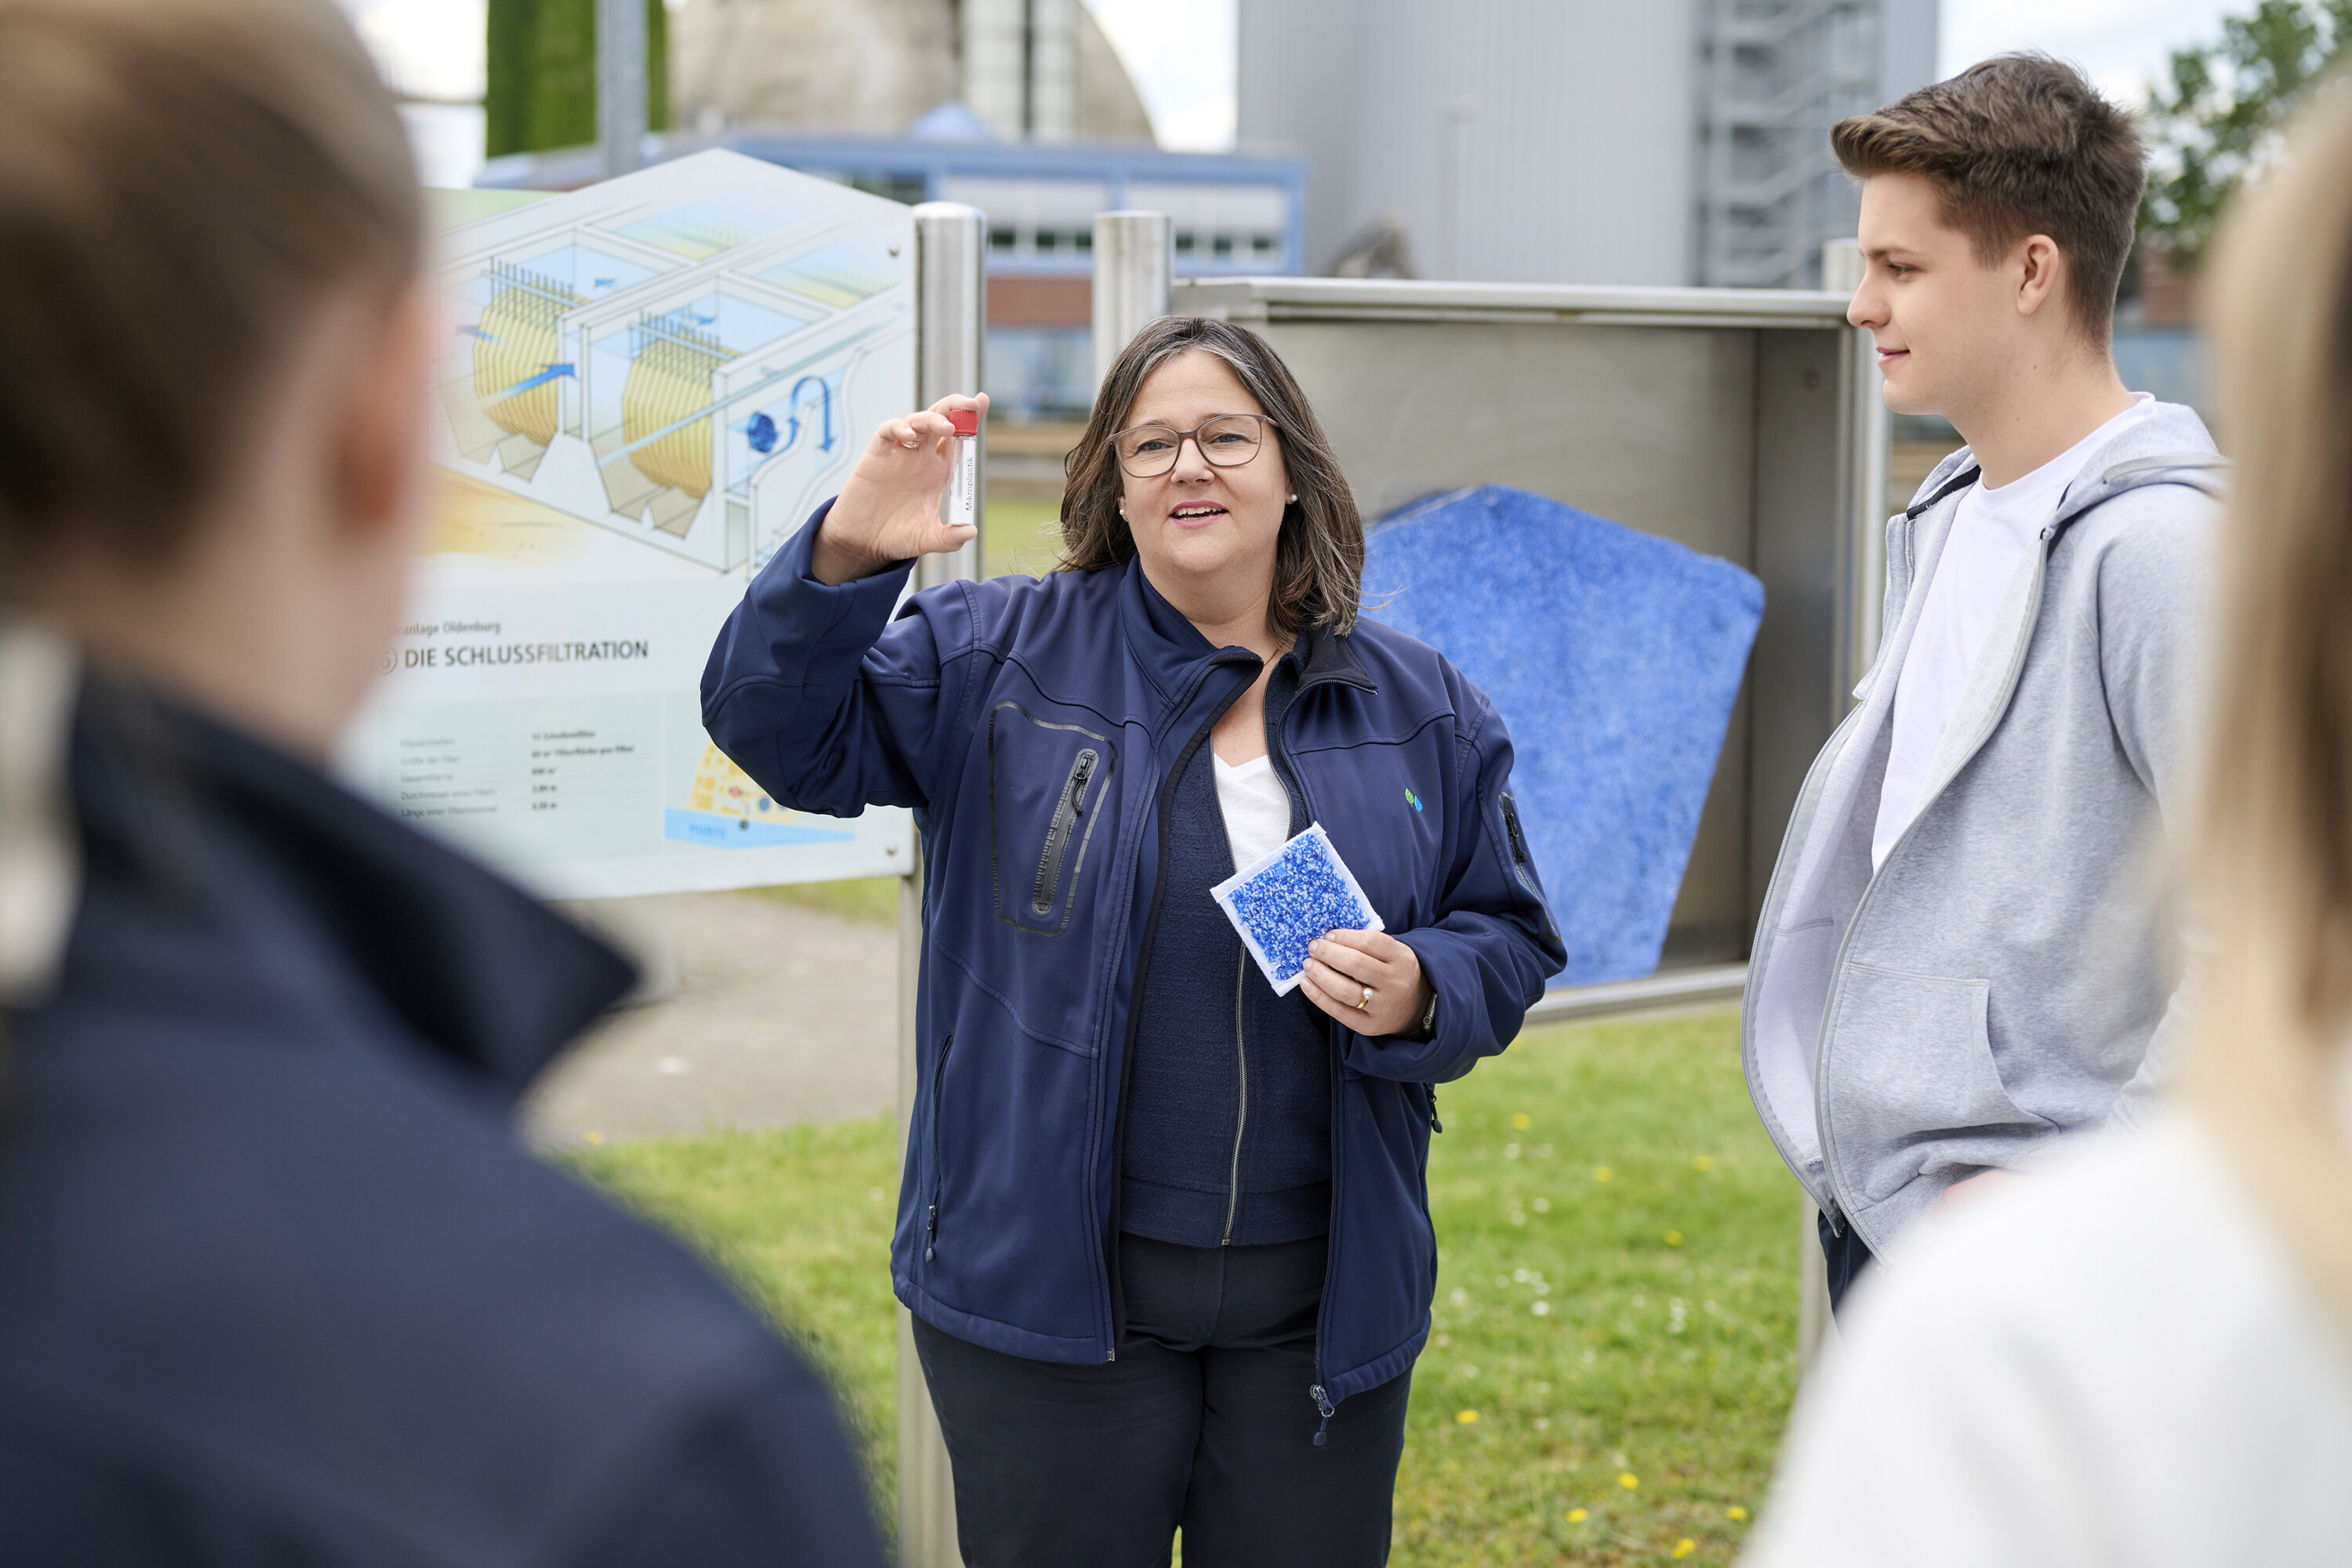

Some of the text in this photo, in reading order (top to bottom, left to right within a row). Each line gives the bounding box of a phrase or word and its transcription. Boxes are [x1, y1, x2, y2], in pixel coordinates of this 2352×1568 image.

[965, 457, 974, 511] Mikroplastik
[394, 620, 502, 639] ranlage Oldenburg
[405, 647, 437, 668] DIE
[445, 640, 649, 667] SCHLUSSFILTRATION
